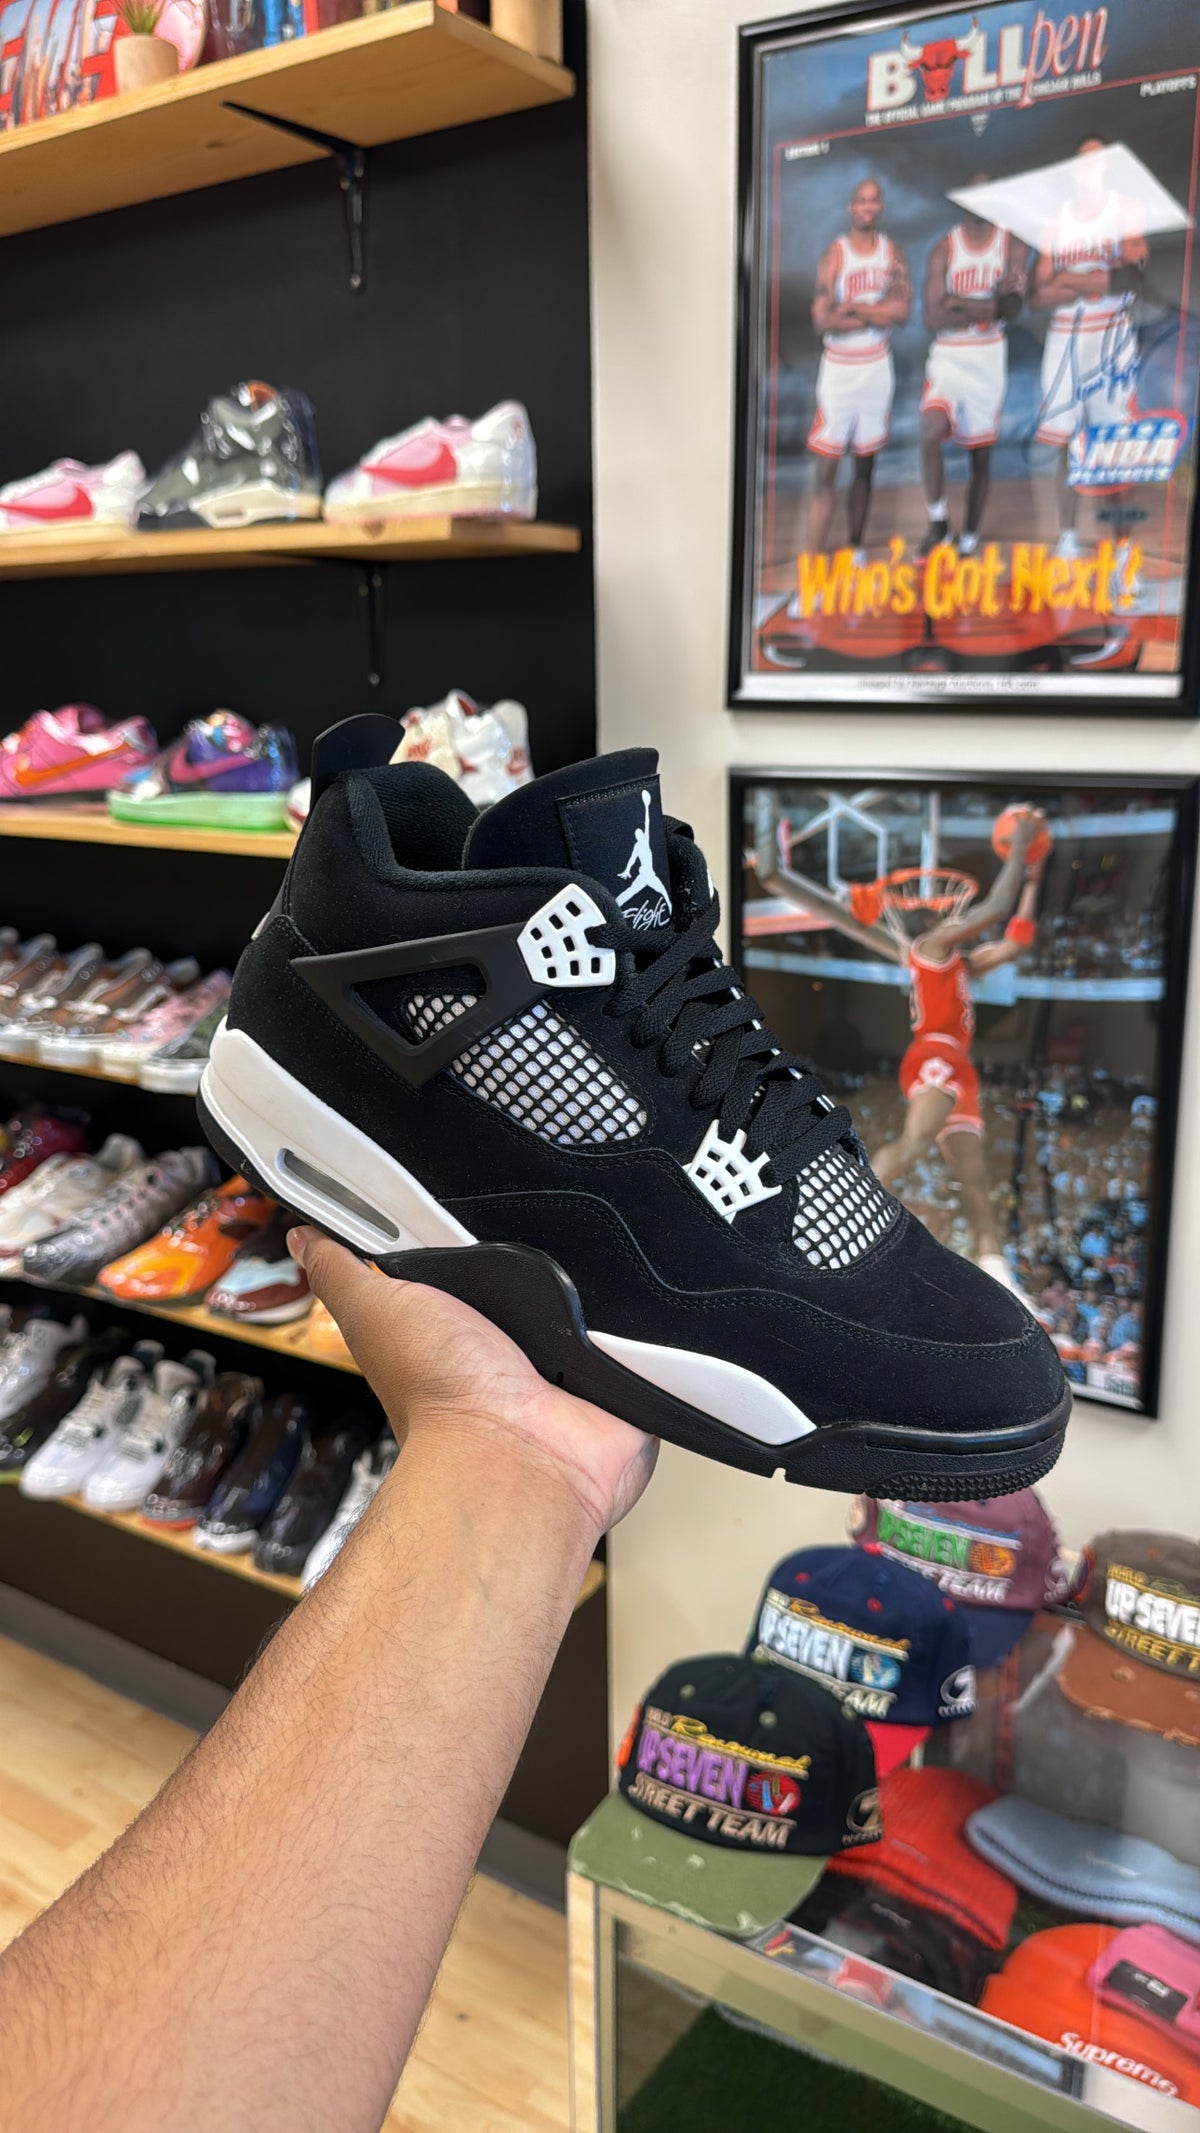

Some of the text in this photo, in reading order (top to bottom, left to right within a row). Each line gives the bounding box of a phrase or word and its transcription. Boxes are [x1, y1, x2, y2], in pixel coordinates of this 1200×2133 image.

[1088, 437, 1180, 470] NBA
[797, 536, 917, 619] Who's
[923, 542, 1004, 619] Got
[622, 896, 671, 931] Flight
[627, 1773, 798, 1849] STREET TEAM
[1060, 2031, 1179, 2098] Supreme
